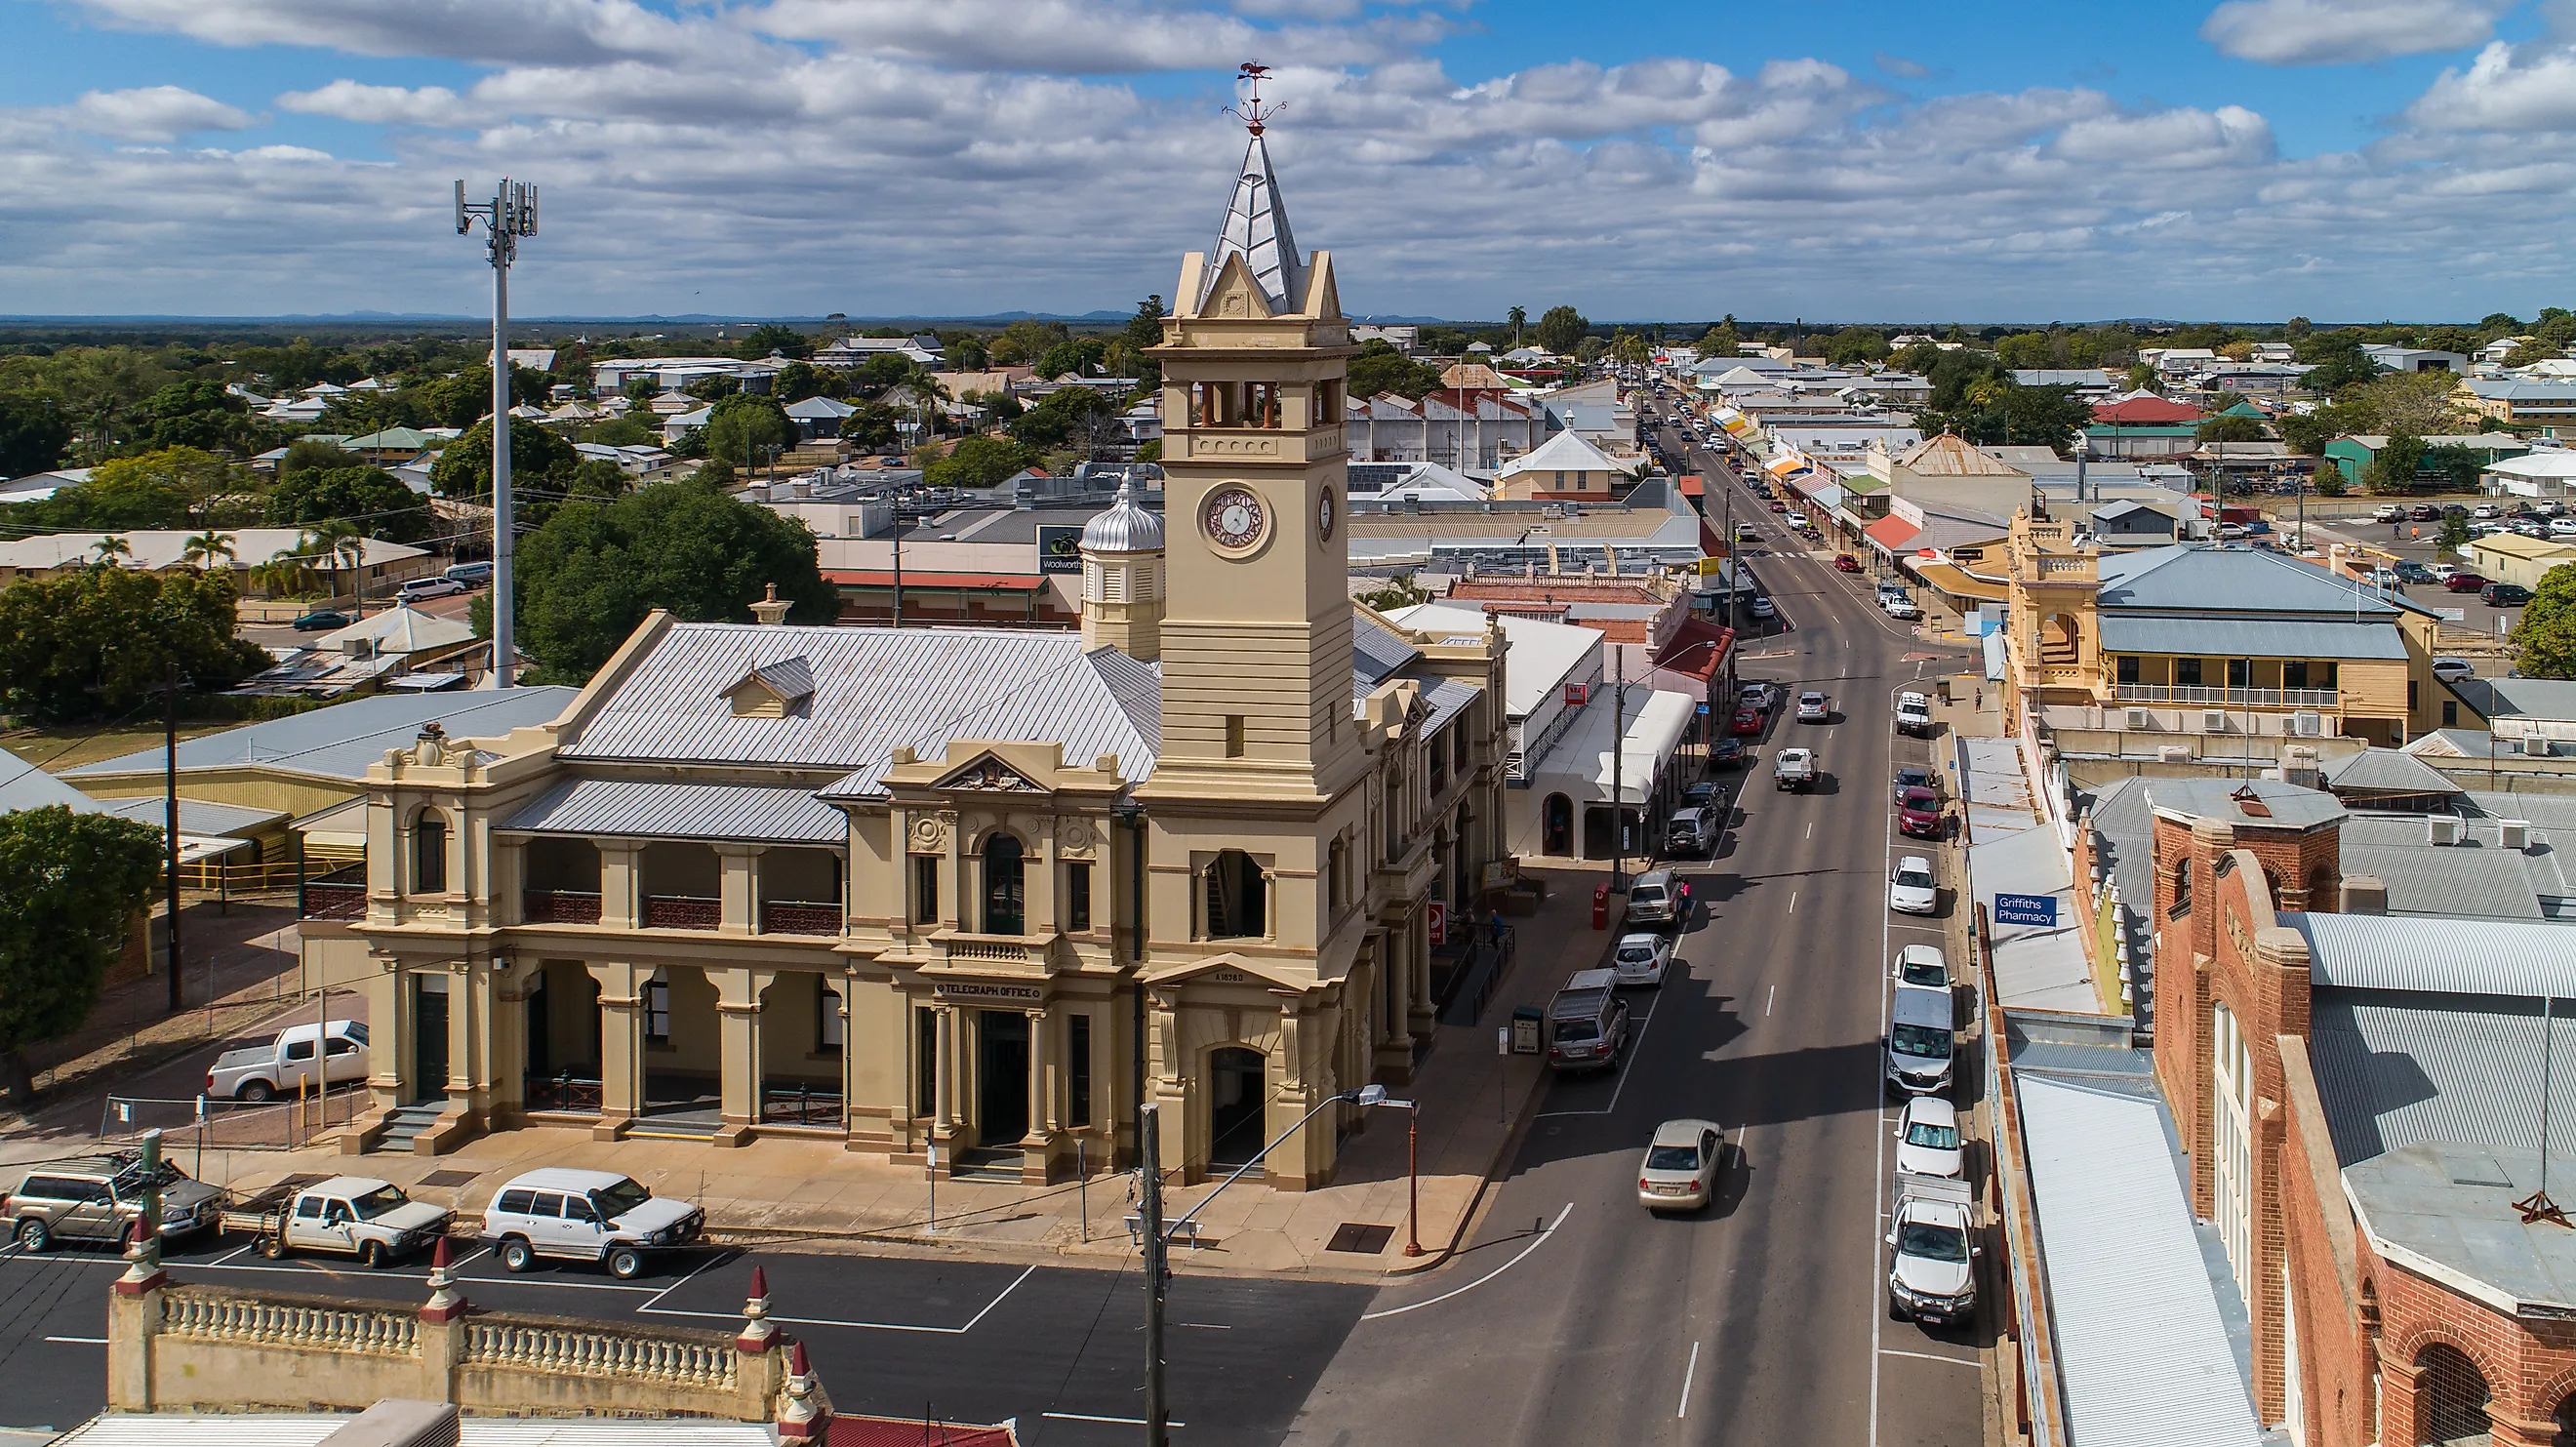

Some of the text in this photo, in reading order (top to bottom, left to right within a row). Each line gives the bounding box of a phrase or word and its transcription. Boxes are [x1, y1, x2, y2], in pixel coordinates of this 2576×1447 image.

[1999, 897, 2042, 909] Griffiths
[1998, 909, 2052, 924] Pharmacy
[946, 984, 1031, 997] TELEGRAPH OFFICE
